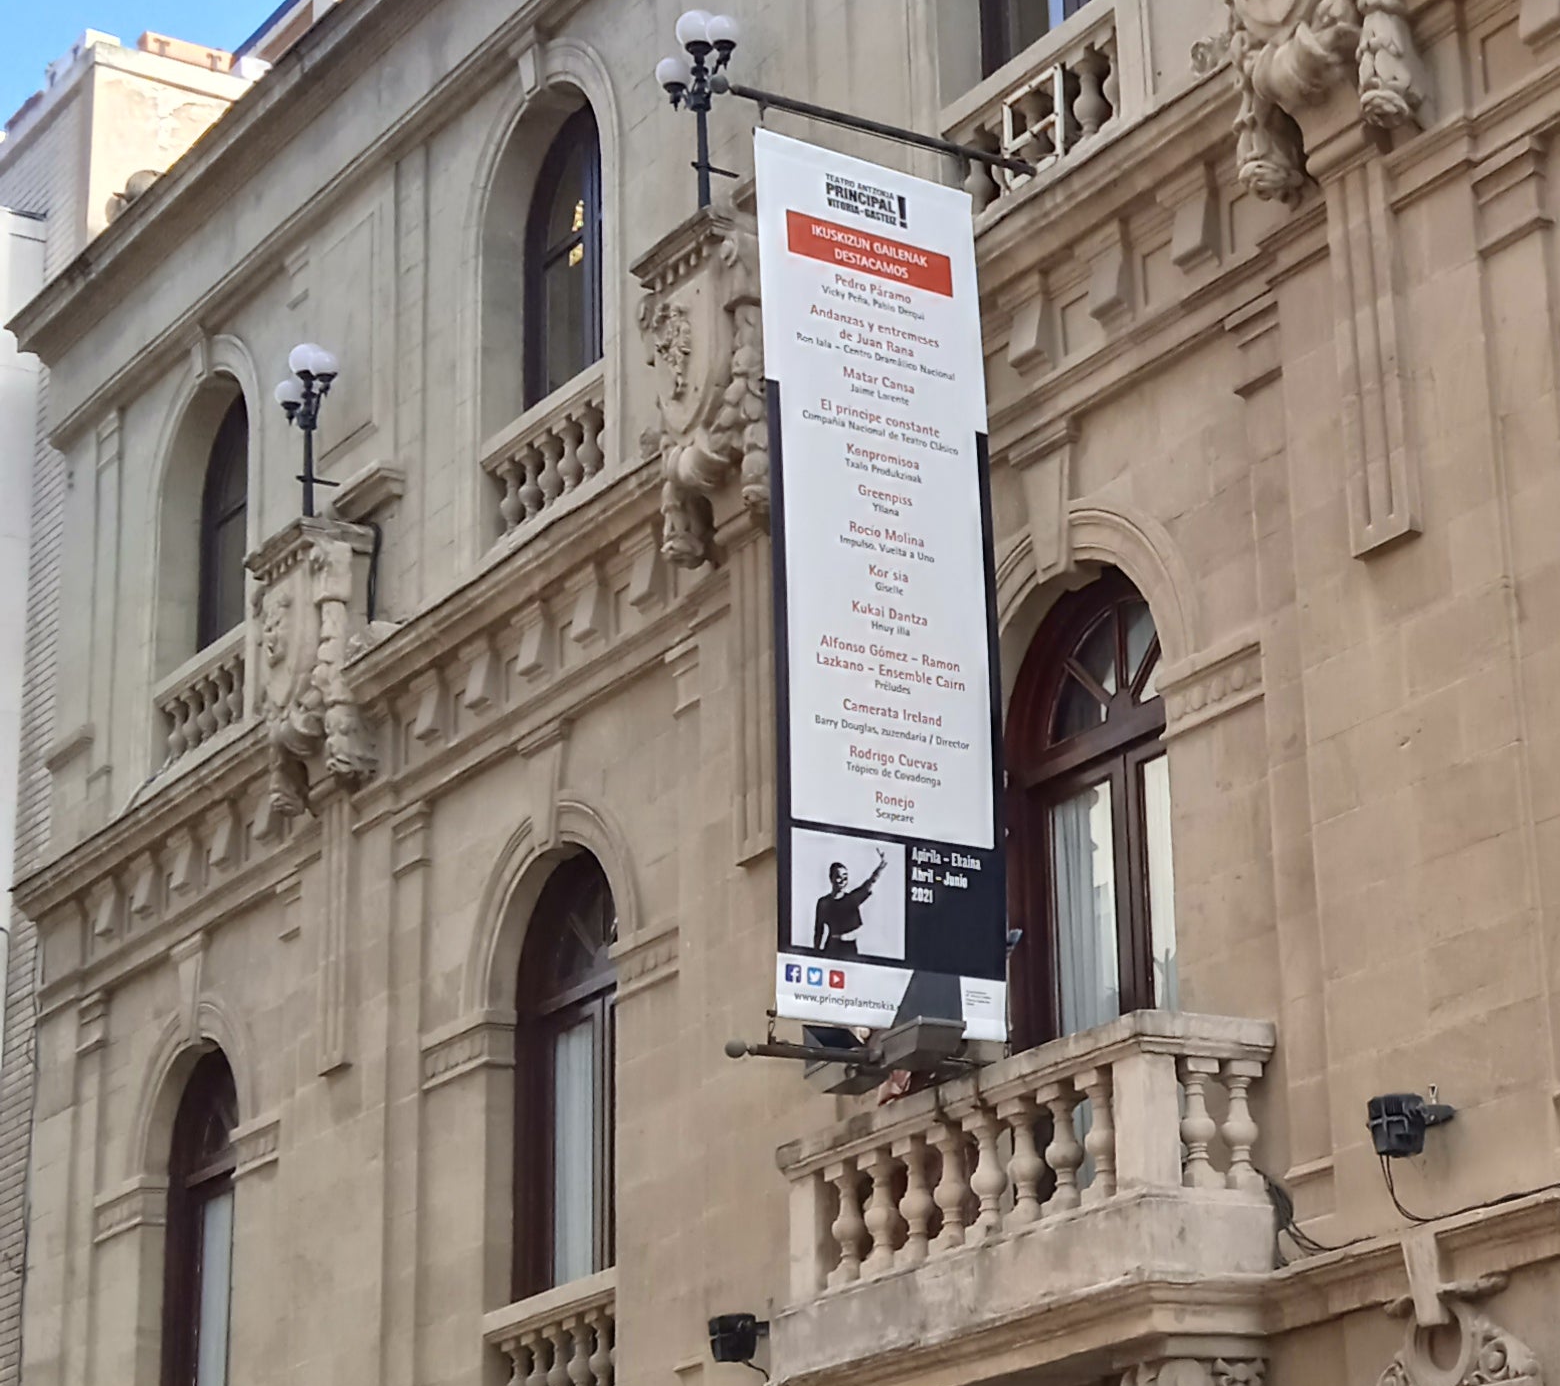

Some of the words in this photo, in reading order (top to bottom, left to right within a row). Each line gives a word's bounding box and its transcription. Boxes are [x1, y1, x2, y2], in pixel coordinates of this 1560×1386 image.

[825, 172, 855, 189] TEATRO
[825, 181, 896, 215] PRINCIPAL
[811, 224, 871, 252] IKUSKIZUN
[873, 242, 928, 268] GAILENAK
[834, 248, 909, 280] DESTACAMOS
[821, 284, 845, 301] Vicky
[834, 273, 867, 293] Pedro
[869, 282, 912, 305] Páramo
[810, 303, 865, 329] Andanzas
[867, 321, 876, 333] y
[877, 324, 940, 350] entremeses
[839, 328, 853, 342] de
[855, 332, 883, 351] Juan
[886, 340, 915, 359] Rana
[843, 343, 873, 359] Centro
[919, 363, 956, 382] Nacional
[843, 365, 879, 386] Matar
[881, 375, 915, 395] Cansa
[850, 384, 875, 398] Jaime
[820, 397, 832, 412] El
[885, 416, 941, 439] constante
[848, 419, 886, 438] Nacional
[888, 429, 899, 441] de
[901, 432, 928, 449] Teatro
[857, 483, 913, 507] Greenpiss
[884, 528, 925, 548] Molina
[878, 542, 907, 558] Vuelta
[909, 551, 915, 560] a
[917, 551, 935, 564] Uno
[868, 564, 889, 579] Kor
[893, 568, 910, 584] sia
[874, 581, 905, 596] Giselle
[851, 600, 885, 618] Kukai
[888, 607, 929, 627] Dantza
[819, 634, 866, 654] Alfonso
[868, 643, 908, 663] Gómez
[921, 654, 961, 673] Ramon
[815, 652, 864, 673] Lazkano
[878, 663, 932, 686] Ensemble
[935, 675, 966, 693] Cairn
[842, 697, 899, 720] Camerata
[902, 708, 943, 728] Ireland
[814, 714, 839, 731] Barry
[880, 728, 927, 744] zuzendaria
[935, 735, 970, 751] Director
[849, 744, 895, 767] Rodrigo
[898, 753, 939, 773] Cuevas
[881, 766, 892, 779] de
[894, 769, 942, 789] Covadonga
[875, 790, 915, 811] Ronejo
[911, 846, 942, 865] Apirila
[951, 852, 982, 872] Ekaina
[911, 866, 934, 884] Abril
[943, 871, 968, 890] Junio
[911, 886, 933, 903] 2021
[794, 991, 901, 1012] www.principalantzokia.
